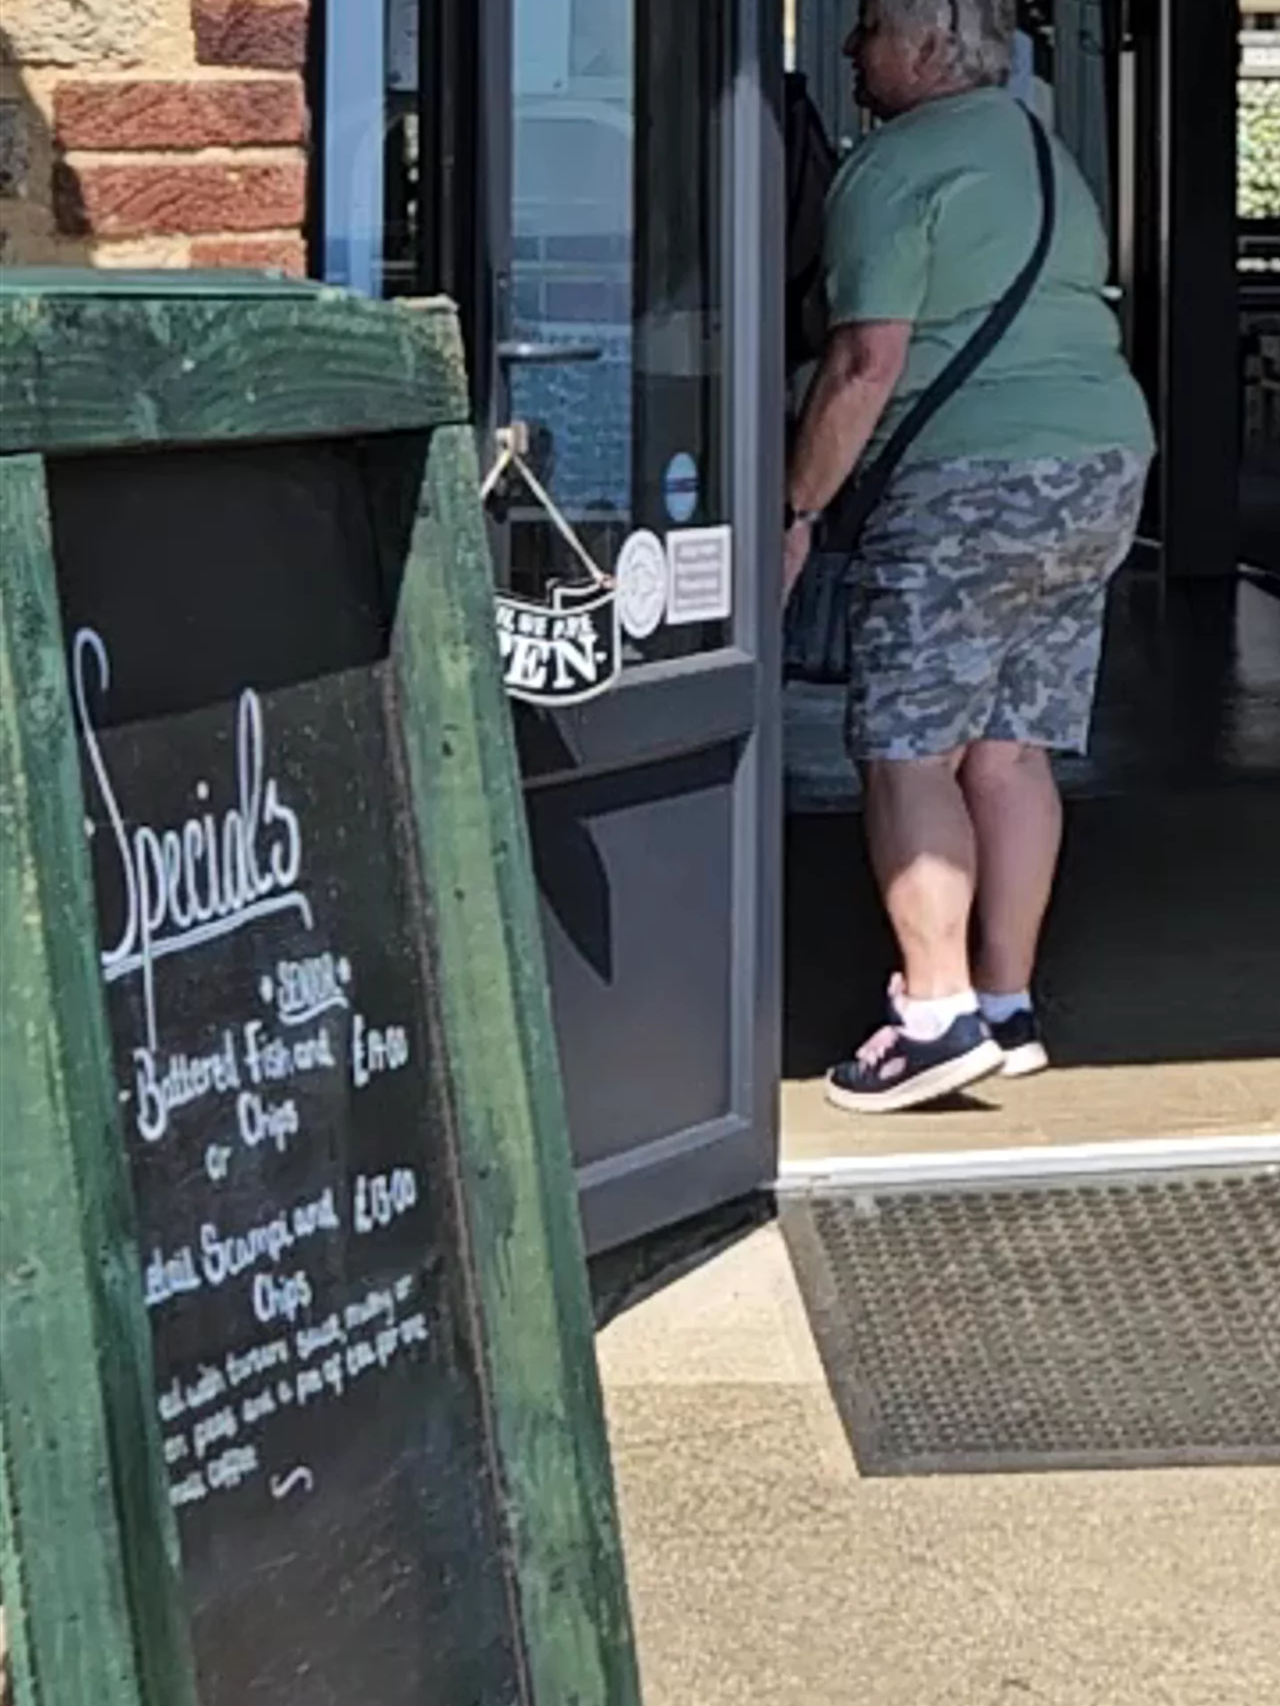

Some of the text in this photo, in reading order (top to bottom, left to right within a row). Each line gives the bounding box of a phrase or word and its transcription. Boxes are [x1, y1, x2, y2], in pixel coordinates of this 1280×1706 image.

[73, 627, 301, 1052] Specials
[134, 1029, 240, 1141] Battered
[243, 1020, 294, 1083] Fish
[237, 1093, 300, 1152] Chips
[254, 1269, 313, 1324] Chips
